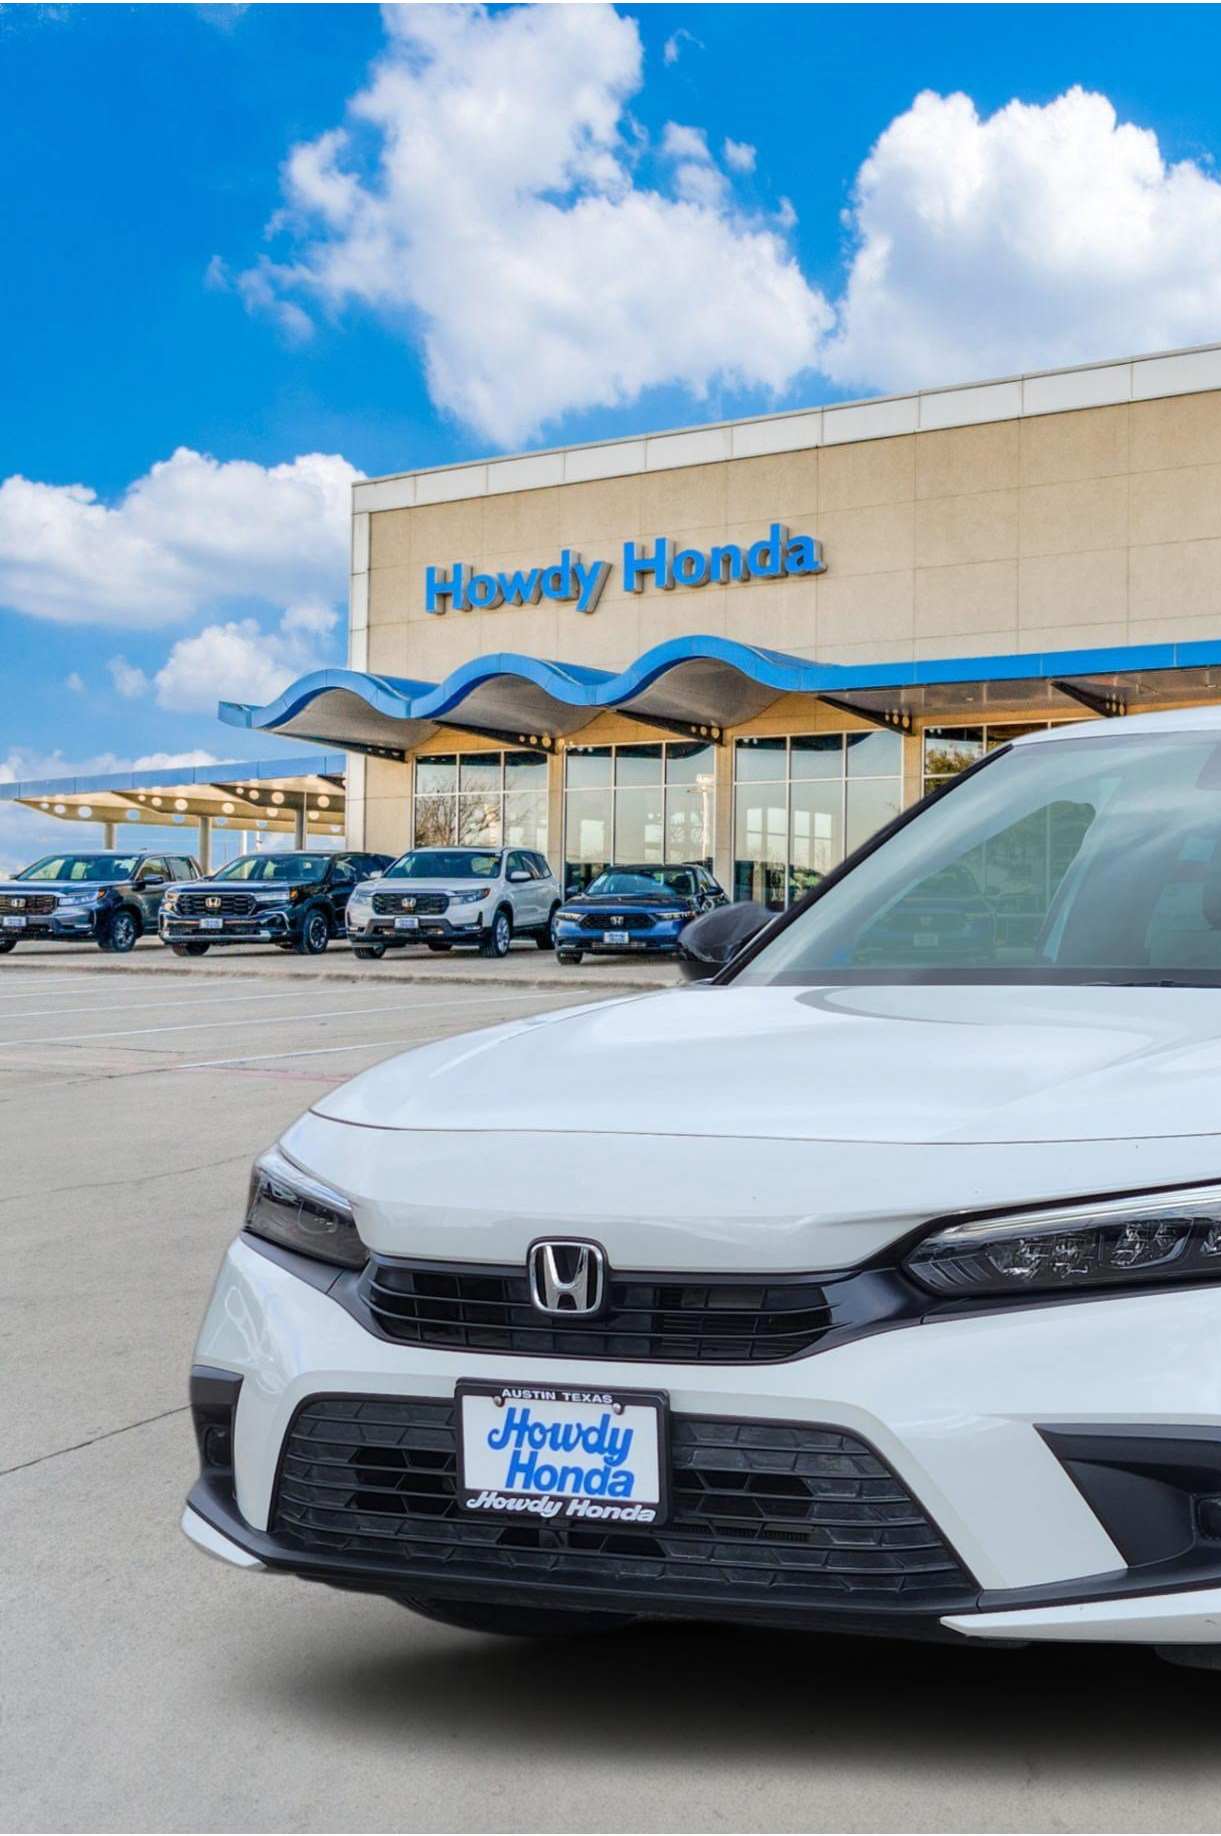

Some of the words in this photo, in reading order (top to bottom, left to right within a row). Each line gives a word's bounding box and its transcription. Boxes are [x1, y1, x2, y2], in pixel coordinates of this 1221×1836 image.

[425, 548, 612, 616] Howdy
[623, 523, 827, 593] Honda
[501, 1387, 556, 1401] AUSTIN
[564, 1392, 613, 1405] TEXAS
[487, 1407, 634, 1467] Howdy
[505, 1450, 634, 1497] Honda
[466, 1491, 562, 1518] Howdy
[566, 1499, 657, 1523] Honda
